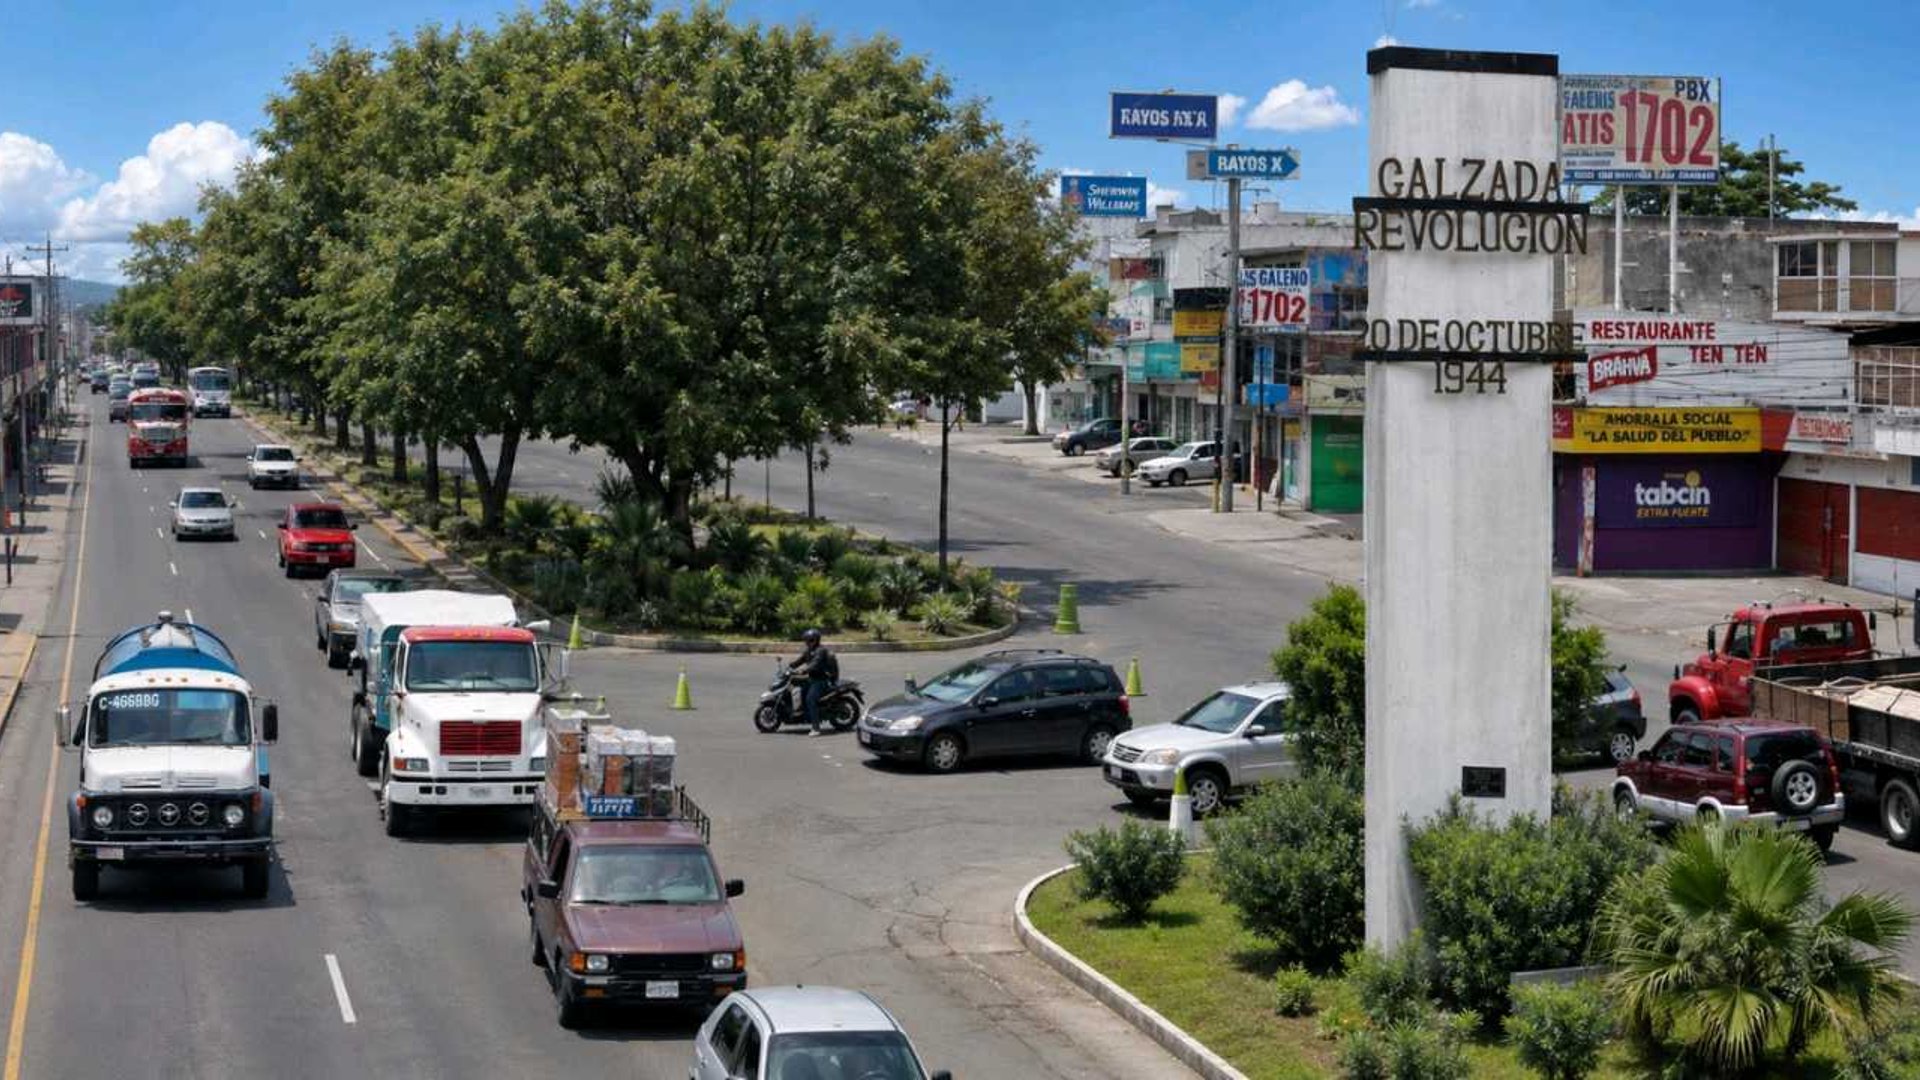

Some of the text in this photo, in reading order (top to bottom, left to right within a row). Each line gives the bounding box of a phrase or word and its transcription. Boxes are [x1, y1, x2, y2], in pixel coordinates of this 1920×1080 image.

[1675, 80, 1711, 102] PBX
[1619, 88, 1714, 166] 1702
[1217, 156, 1283, 172] RAYOS X
[1259, 269, 1308, 286] GALENO
[1248, 288, 1306, 323] 1702
[1397, 319, 1440, 350] DE
[1444, 319, 1585, 353] OCTUBRE
[1591, 321, 1716, 340] RESTAURANTE
[1689, 345, 1767, 363] TEN TEN
[1434, 360, 1508, 394] 1944
[1683, 412, 1732, 425] SOCIAL
[1613, 430, 1657, 443] SALUD
[1661, 430, 1686, 442] DEL
[1635, 481, 1711, 505] tabcin
